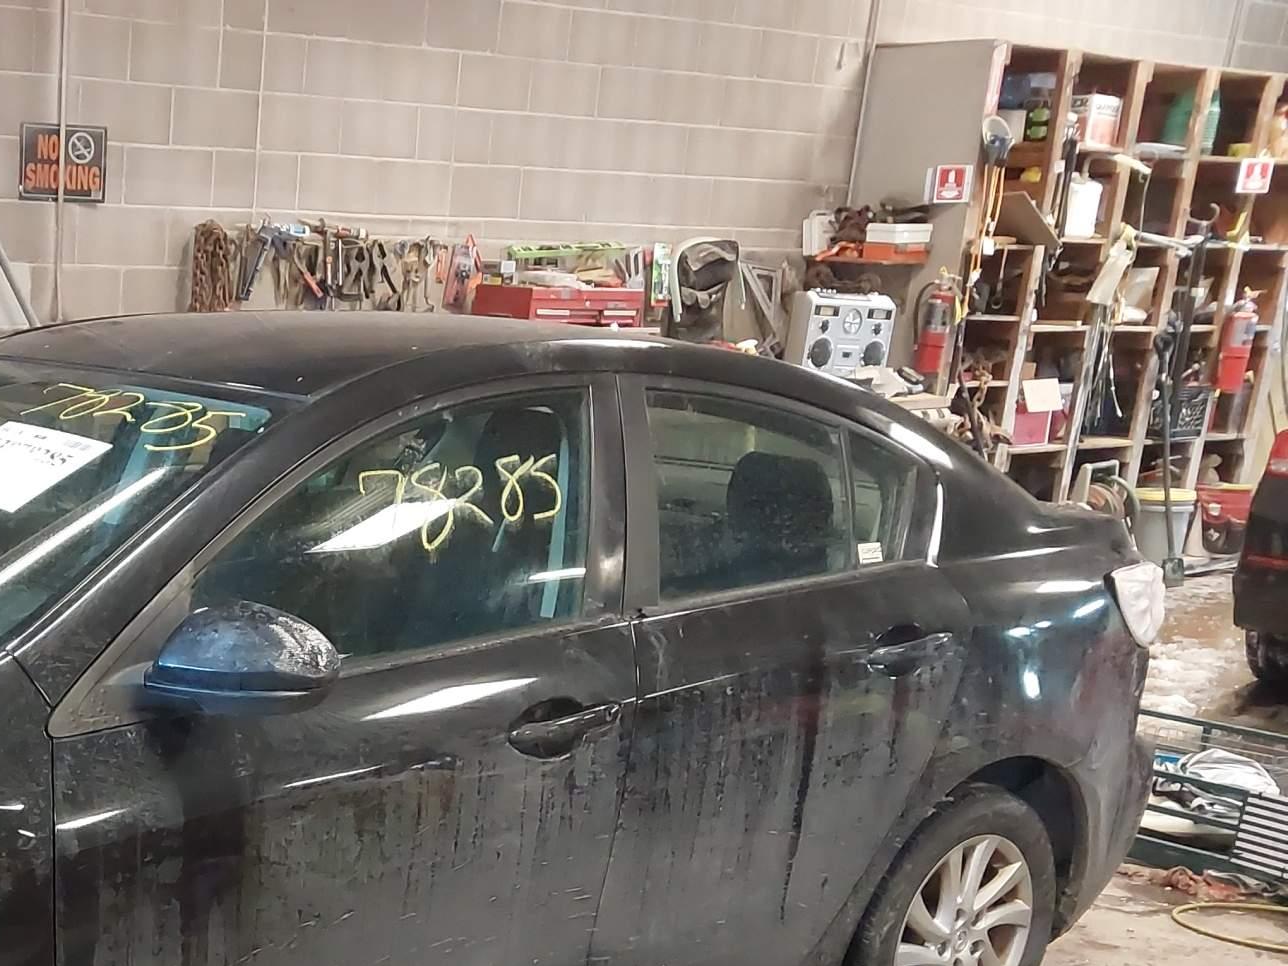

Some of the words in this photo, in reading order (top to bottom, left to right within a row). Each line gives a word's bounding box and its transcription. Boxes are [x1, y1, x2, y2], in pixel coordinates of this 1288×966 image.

[37, 133, 60, 160] NO
[25, 162, 101, 192] SMOKING
[358, 453, 562, 552] 78285
